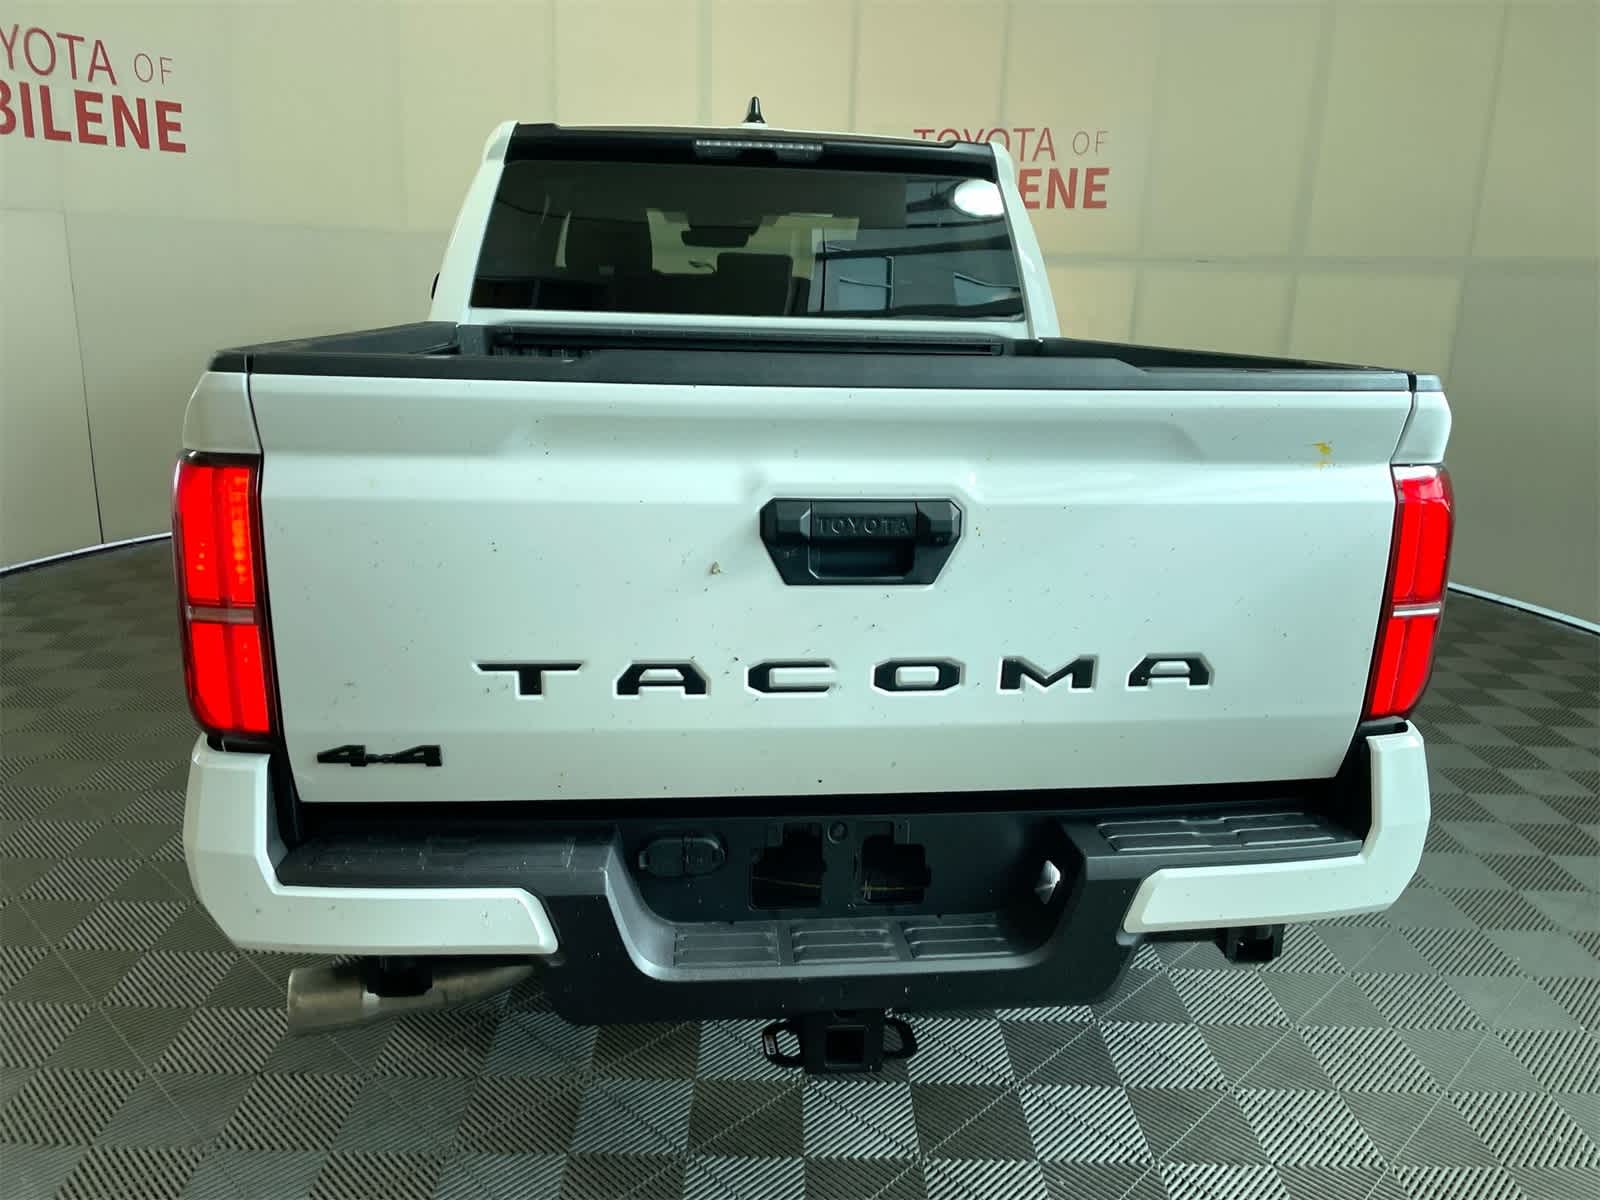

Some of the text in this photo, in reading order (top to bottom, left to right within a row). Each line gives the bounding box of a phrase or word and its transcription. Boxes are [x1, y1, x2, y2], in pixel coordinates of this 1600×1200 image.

[133, 52, 173, 85] OF
[1072, 130, 1109, 156] OF
[815, 517, 911, 536] TOYOTA
[475, 654, 1212, 698] TACOMA
